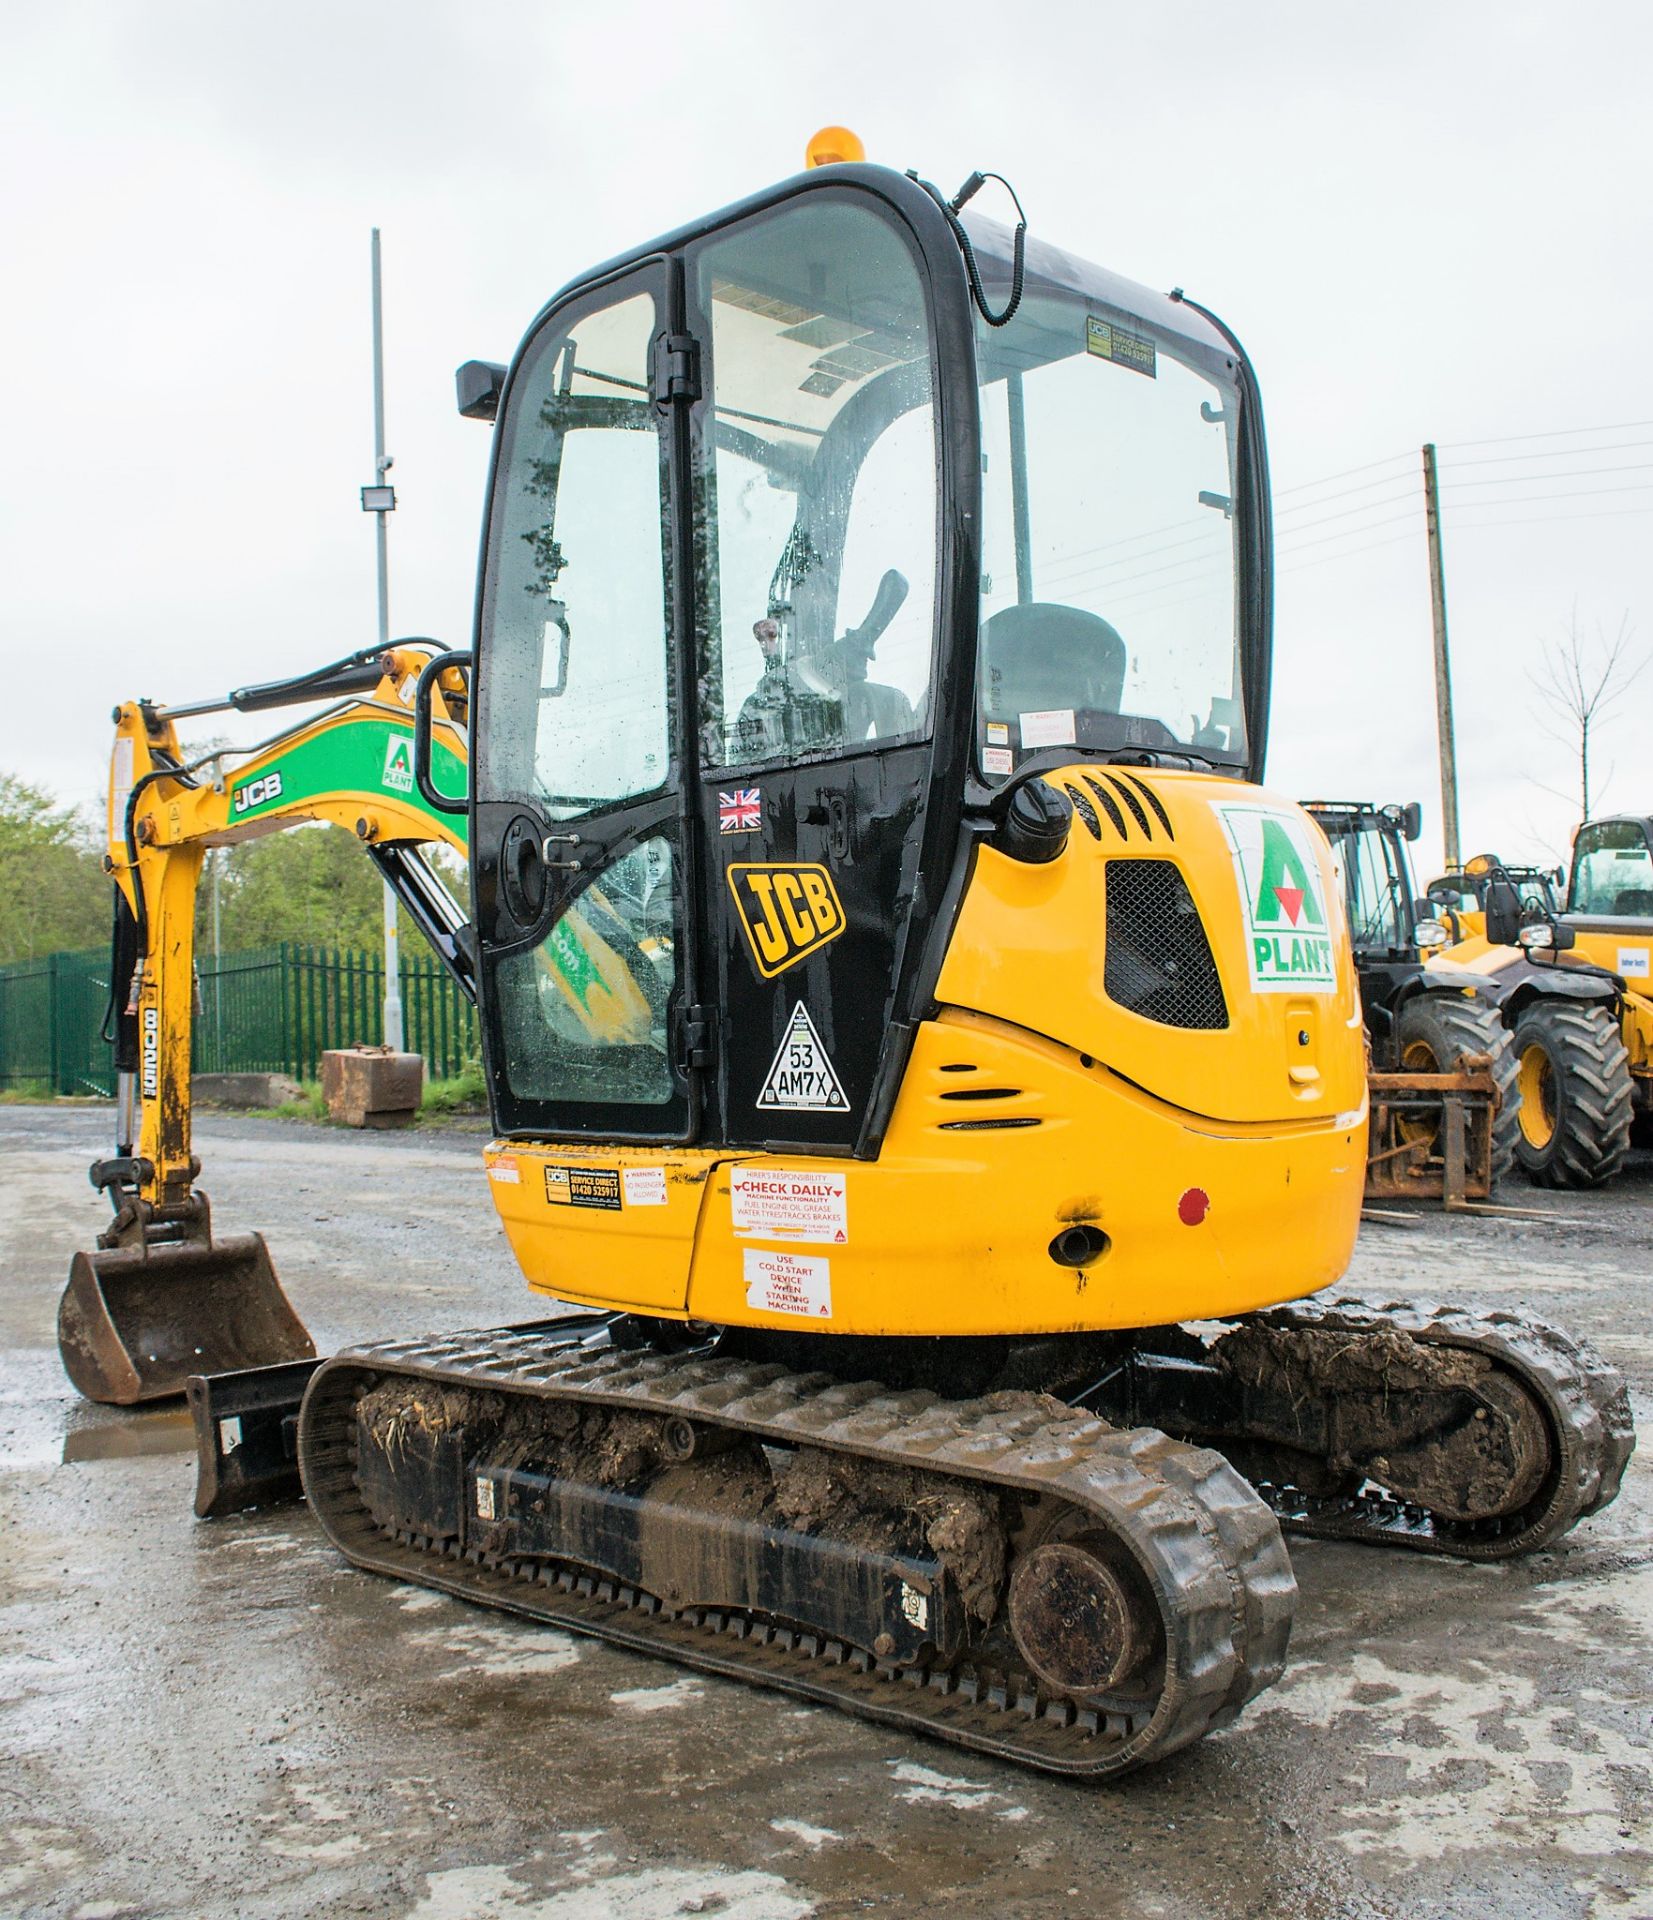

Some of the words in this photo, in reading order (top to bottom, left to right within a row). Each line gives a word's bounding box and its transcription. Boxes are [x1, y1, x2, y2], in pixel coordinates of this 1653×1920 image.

[1091, 323, 1108, 337] JCB
[390, 742, 411, 773] A
[384, 773, 413, 788] PLANT
[234, 772, 283, 812] JCB
[1255, 819, 1324, 925] A
[746, 873, 838, 964] JCB
[1253, 936, 1332, 974] PLANT
[790, 1044, 813, 1069] 53
[778, 1071, 828, 1097] AM7X
[548, 1170, 568, 1182] JCB
[570, 1176, 594, 1185] SERVICE
[595, 1178, 618, 1187] DIRECT
[747, 1171, 771, 1179] HIRER'S
[772, 1173, 827, 1181] RESPONSIBILITY
[571, 1184, 592, 1195] 01420
[592, 1186, 618, 1197] 525917
[742, 1181, 787, 1194] CHECK
[792, 1184, 833, 1196] DAILY
[776, 1195, 828, 1203] FUNCTIONALITY
[744, 1200, 760, 1209] FUEL
[762, 1202, 788, 1211] ENGINE
[804, 1205, 832, 1213] GREASE
[737, 1208, 760, 1216] WATER
[761, 1209, 812, 1220] TYRES/TRACKS
[813, 1212, 841, 1221] BRAKES
[776, 1256, 794, 1264] USE
[759, 1262, 784, 1272] COLD
[785, 1266, 813, 1276] START
[770, 1273, 802, 1284] DEVICE
[772, 1283, 801, 1293] WHEN
[766, 1291, 809, 1304] STARTING
[768, 1301, 809, 1313] MACHINE
